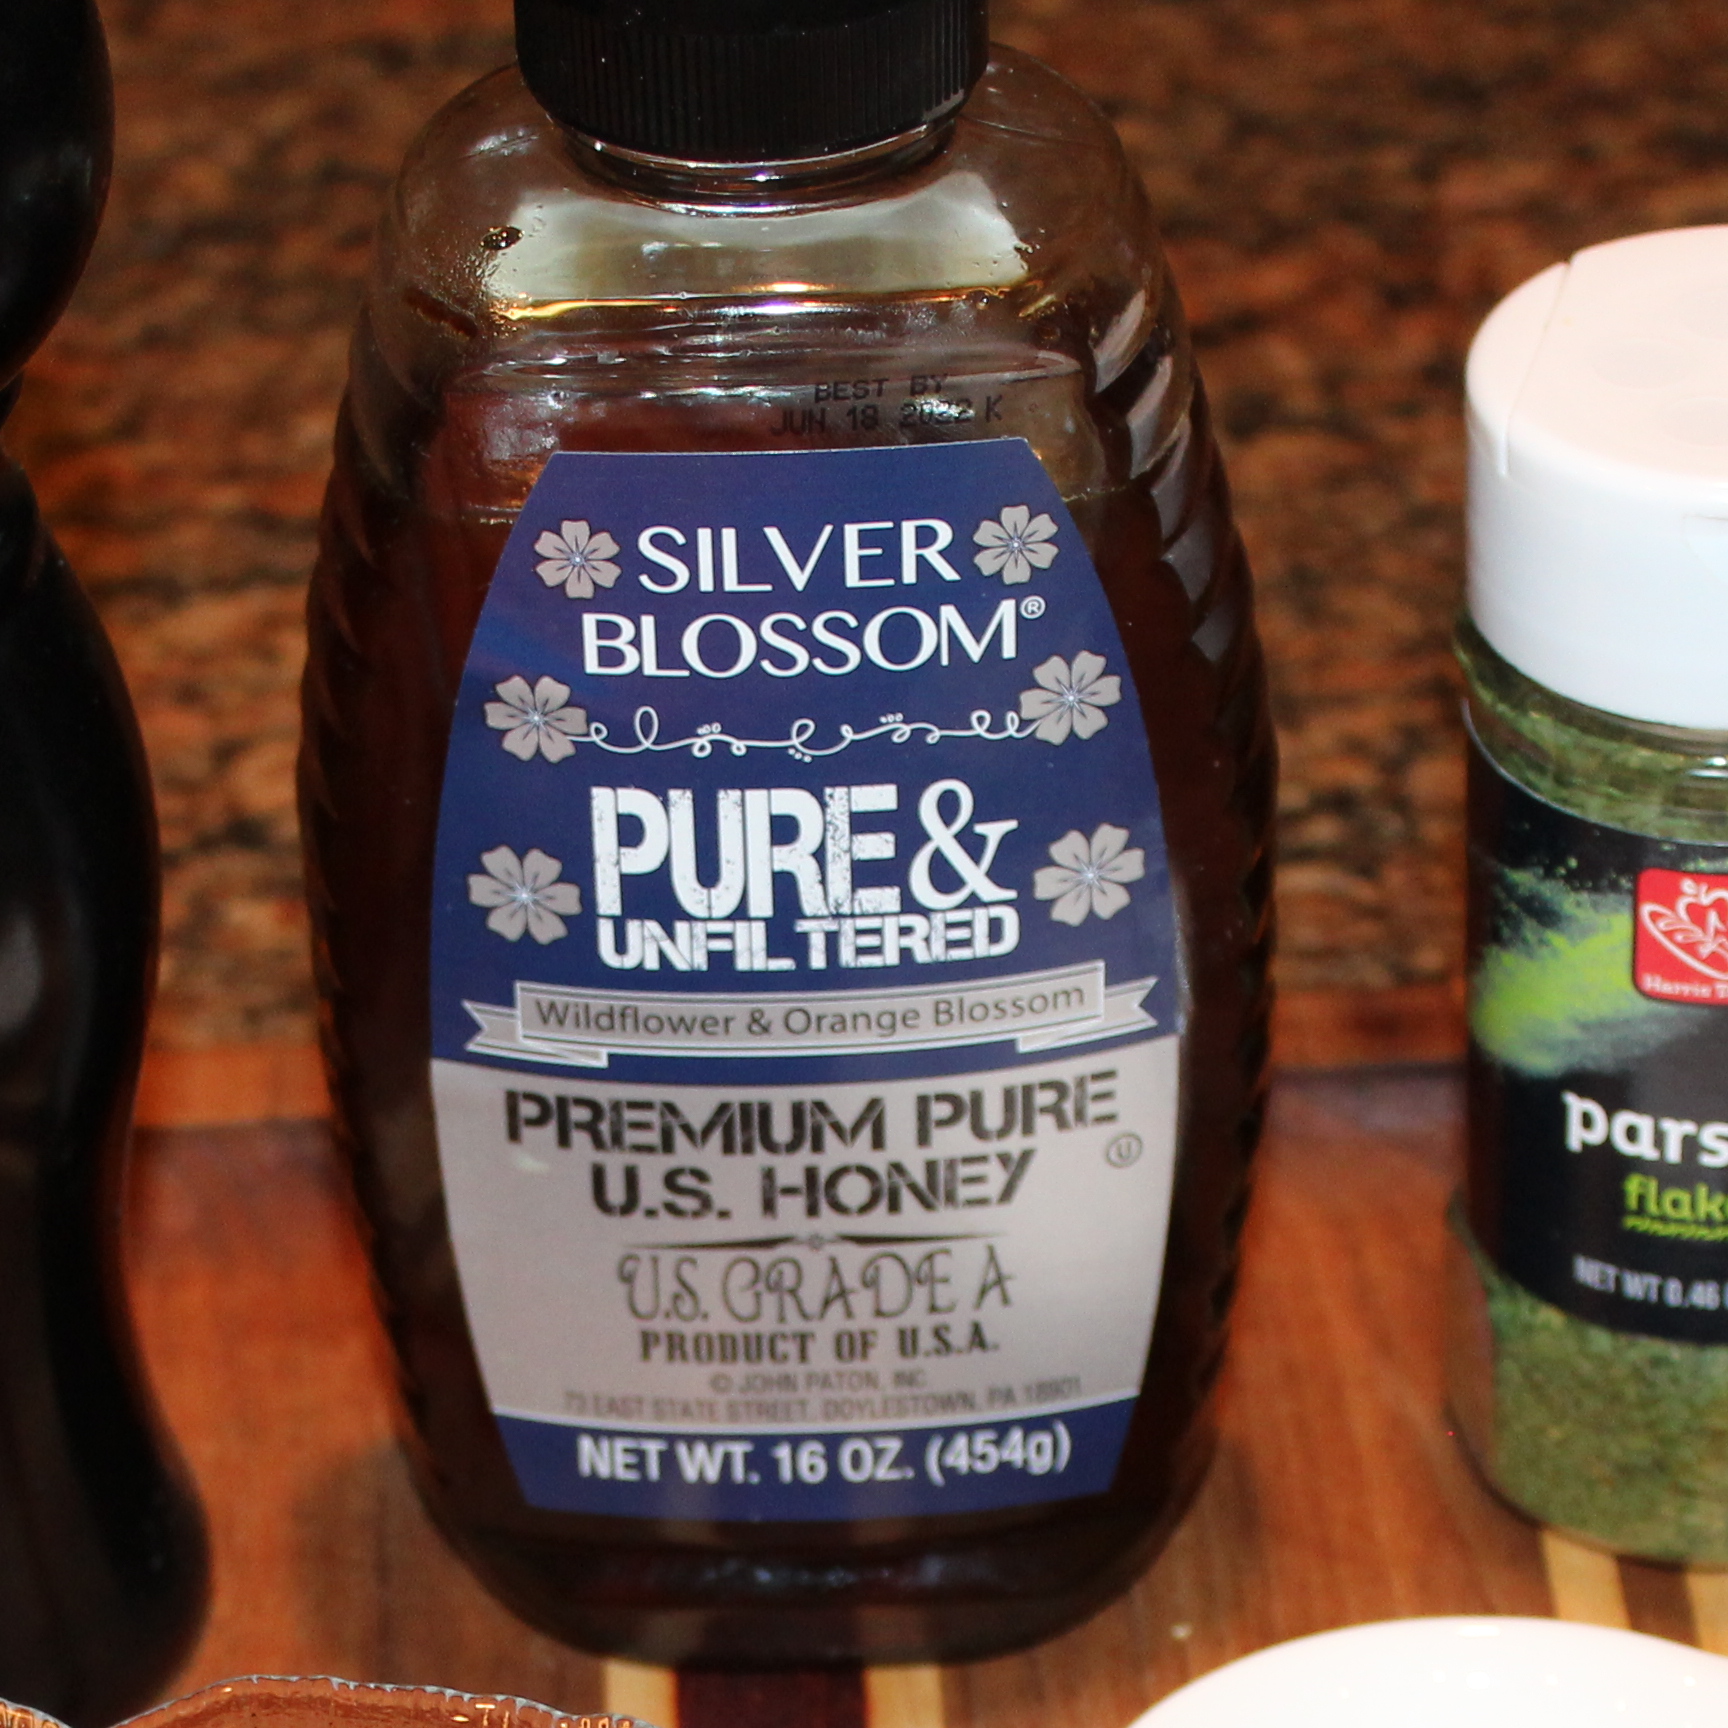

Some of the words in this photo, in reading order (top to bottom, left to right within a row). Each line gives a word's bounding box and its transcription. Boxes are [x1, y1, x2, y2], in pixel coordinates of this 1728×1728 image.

[772, 407, 826, 435] JUN
[815, 378, 889, 403] BEST
[910, 374, 948, 396] BY
[637, 517, 962, 595] SILVER
[595, 903, 1021, 972] UNFILTERED
[535, 999, 735, 1035] Wildflower
[747, 1008, 771, 1035] &
[784, 1006, 921, 1038] Orange
[934, 986, 1086, 1028] Blossom
[504, 1089, 885, 1156] PREMIUM
[916, 1069, 1119, 1148] PURE
[591, 1162, 732, 1220] U.S.
[761, 1148, 1037, 1219] HONEY
[617, 1253, 709, 1323] U.S.
[722, 1248, 957, 1325] GRADE
[975, 1244, 1016, 1309] A
[1574, 1253, 1618, 1293] NET
[640, 1330, 816, 1364] PRODUCT
[833, 1327, 877, 1362] OF
[898, 1321, 1000, 1358] U.S.A.
[577, 1433, 668, 1482] NET
[674, 1440, 761, 1485] WT.
[771, 1439, 828, 1485] 16
[837, 1435, 915, 1483] OZ.
[924, 1419, 1071, 1487] (454g)
